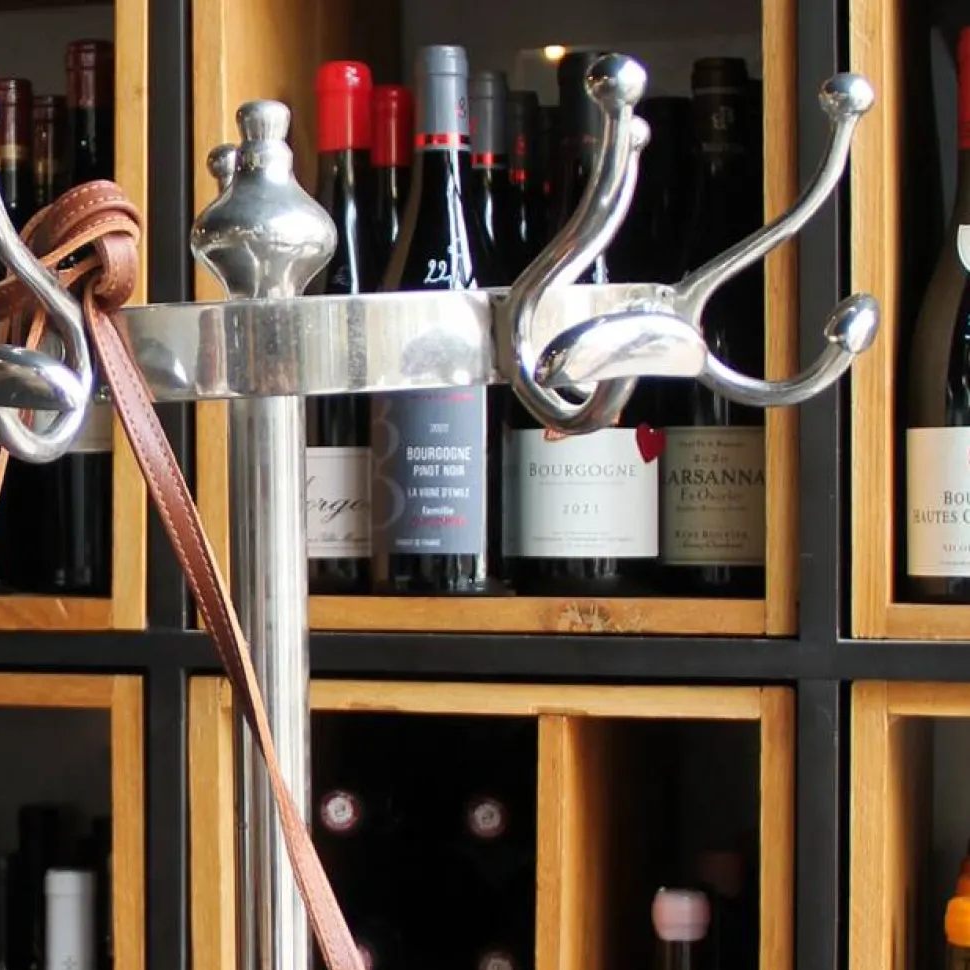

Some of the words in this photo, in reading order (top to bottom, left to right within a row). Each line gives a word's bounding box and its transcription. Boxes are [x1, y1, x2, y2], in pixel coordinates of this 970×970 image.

[406, 446, 473, 461] BOURGOGNE
[413, 464, 440, 477] PINOT
[529, 462, 638, 478] BOURGOGNE
[664, 468, 764, 487] ARSANNA
